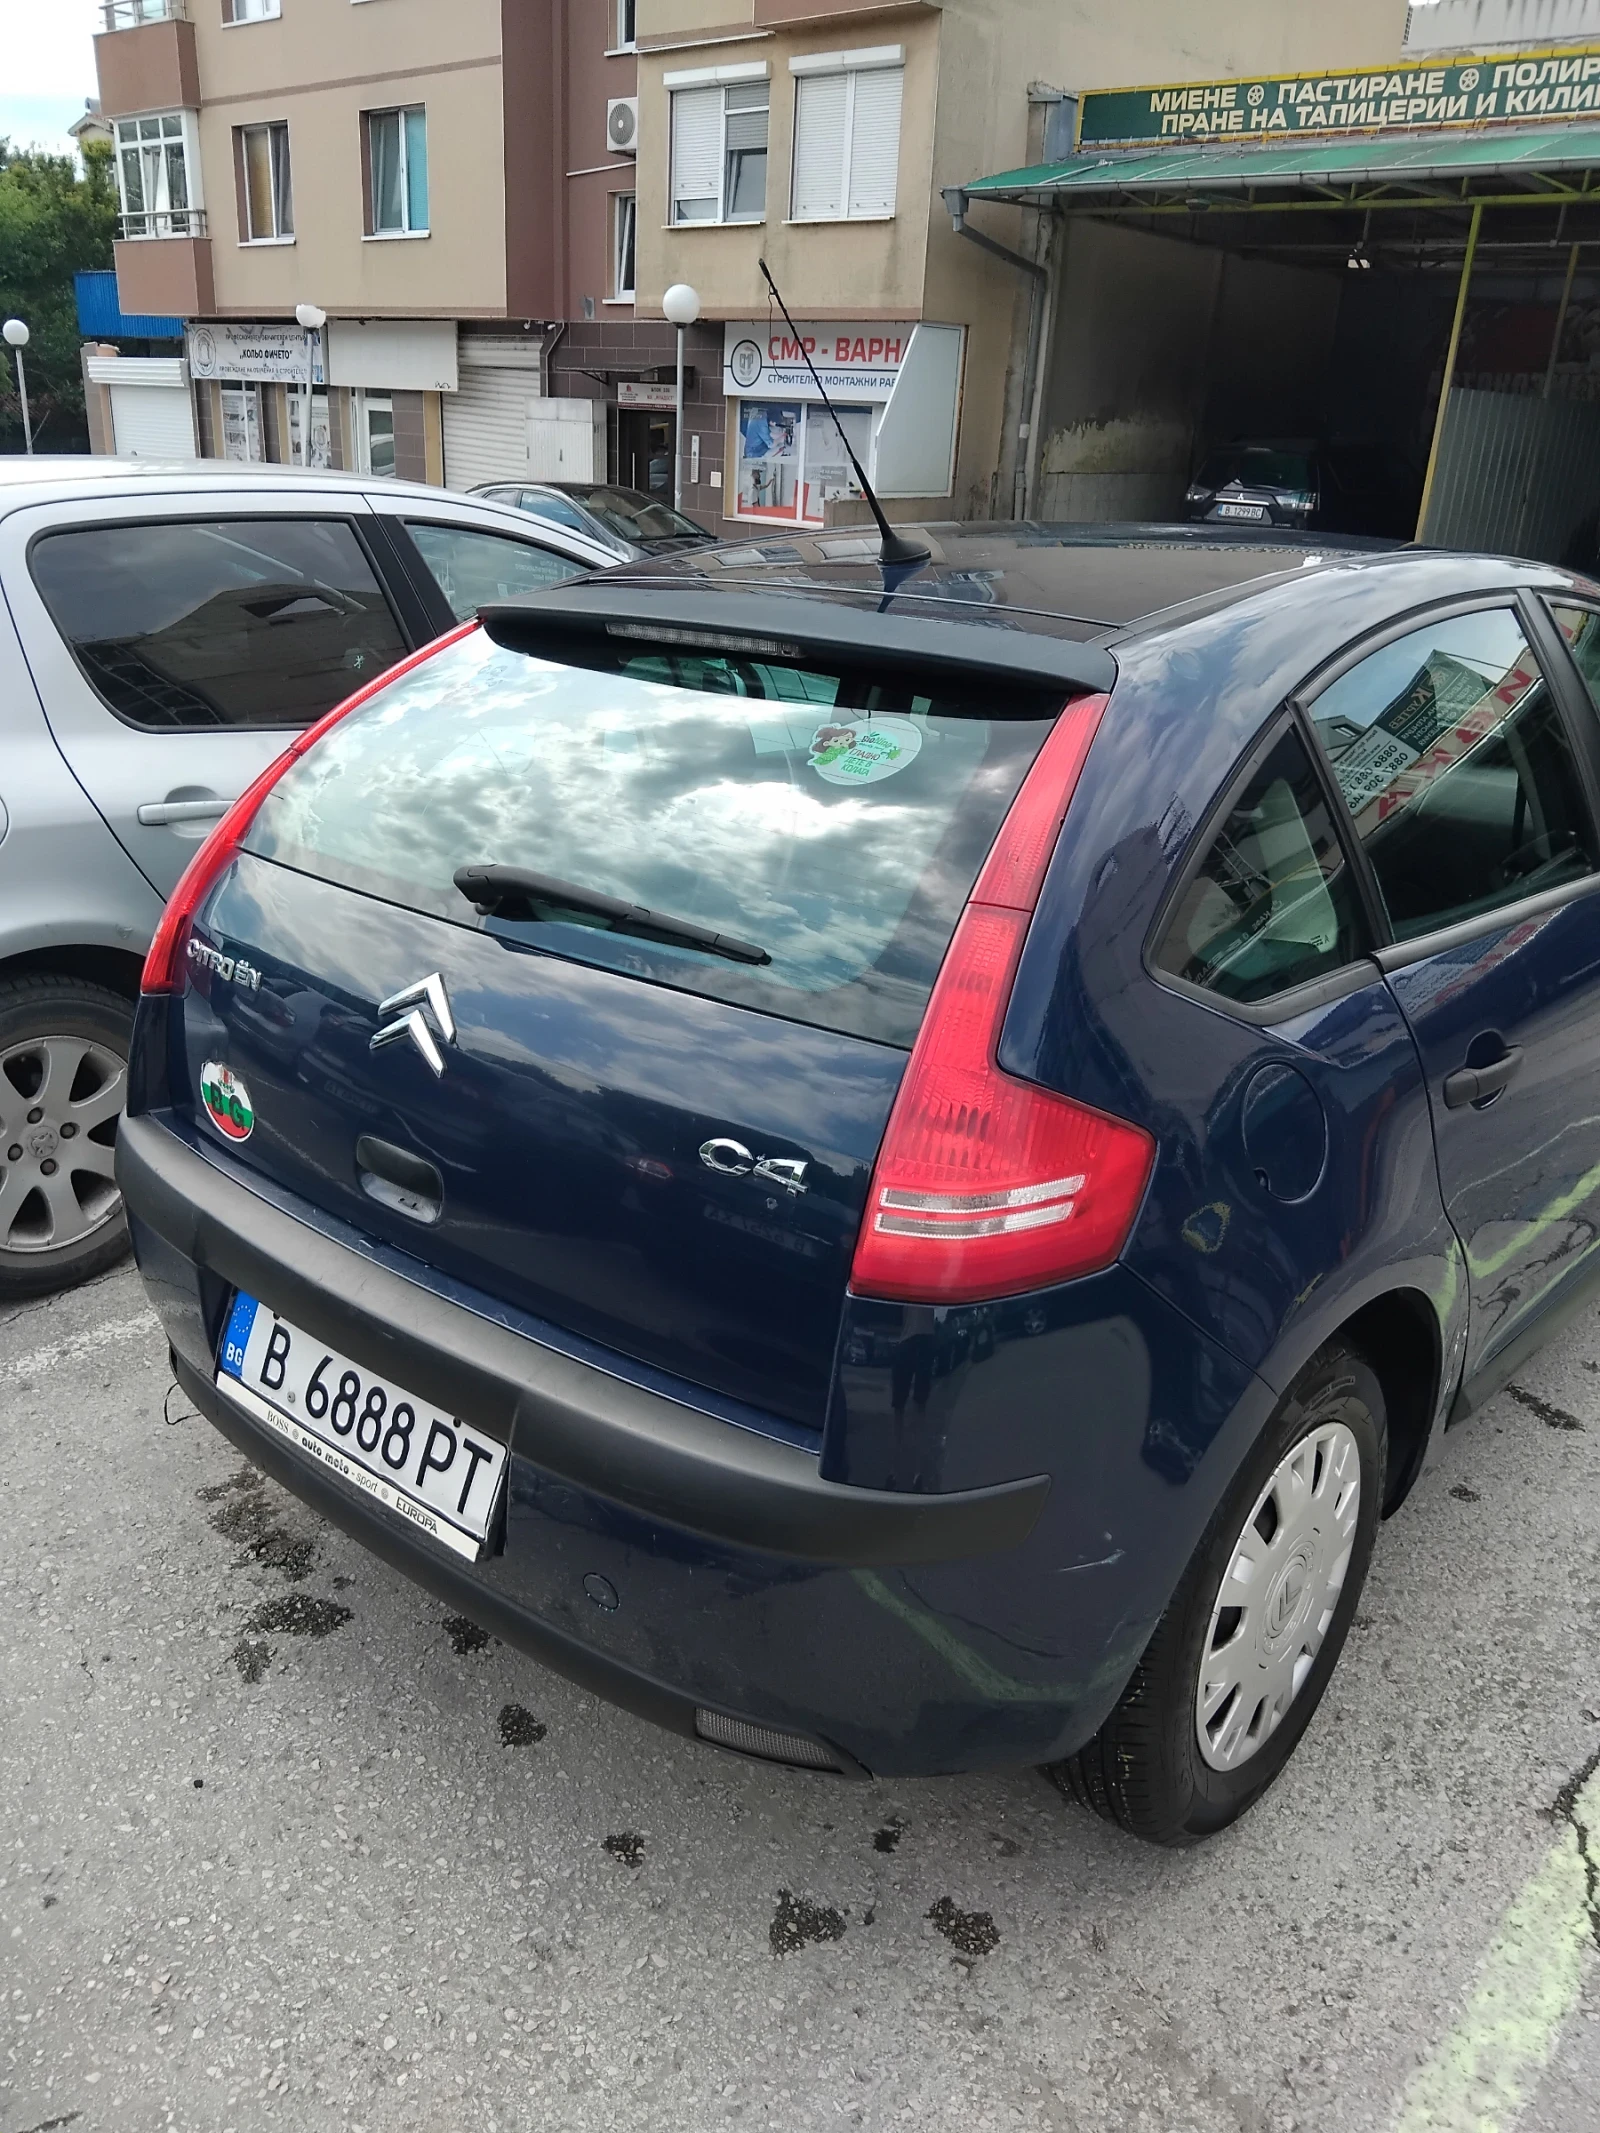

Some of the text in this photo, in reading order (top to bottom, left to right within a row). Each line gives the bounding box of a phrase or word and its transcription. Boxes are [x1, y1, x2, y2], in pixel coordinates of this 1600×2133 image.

[1150, 57, 1600, 112] МИЕНЕ ПАСТИРАНЕ ПОЛИР
[1161, 83, 1600, 134] ПРАНЕ НА ТАПИЦЕРИИ И КИЛИ
[768, 336, 816, 361] СМР
[834, 337, 908, 363] ВАРН
[824, 376, 877, 388] МОНТАЖНИ
[186, 938, 263, 992] CITROËN
[699, 1138, 809, 1197] C4
[226, 1341, 243, 1367] BG
[260, 1323, 494, 1515] B 6888 PT
[266, 1410, 290, 1434] BOSS
[301, 1436, 322, 1459] auto
[324, 1452, 350, 1476] moto
[356, 1470, 379, 1494] sport
[395, 1496, 438, 1535] EUROPA
